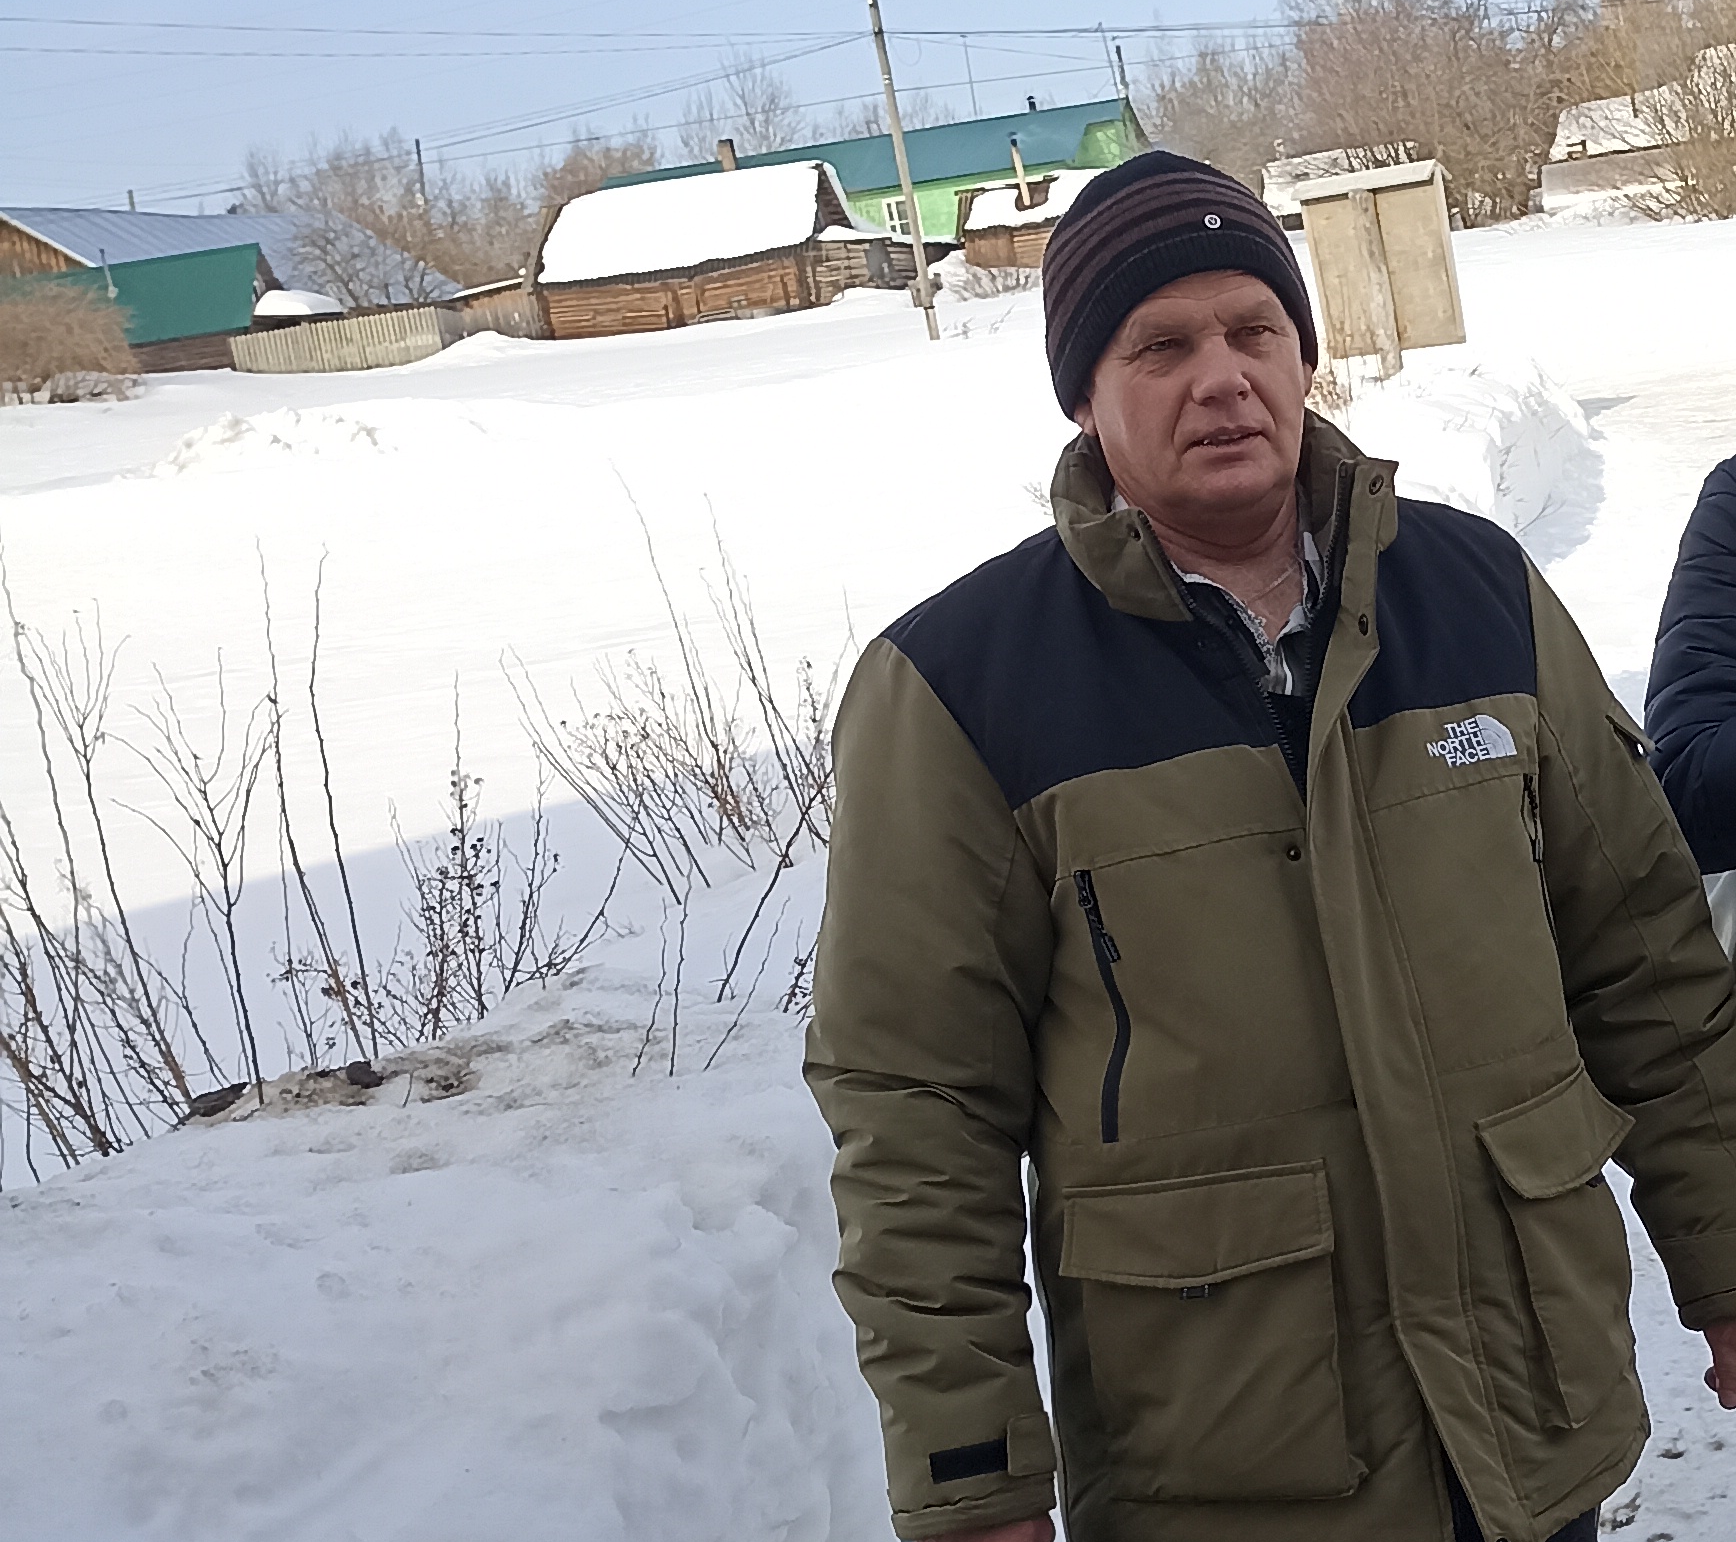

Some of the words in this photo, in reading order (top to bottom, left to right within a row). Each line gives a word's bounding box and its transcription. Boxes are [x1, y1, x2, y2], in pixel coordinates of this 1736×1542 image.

[1443, 717, 1480, 738] THE
[1426, 730, 1486, 757] NORTH
[1445, 745, 1491, 768] FACE
